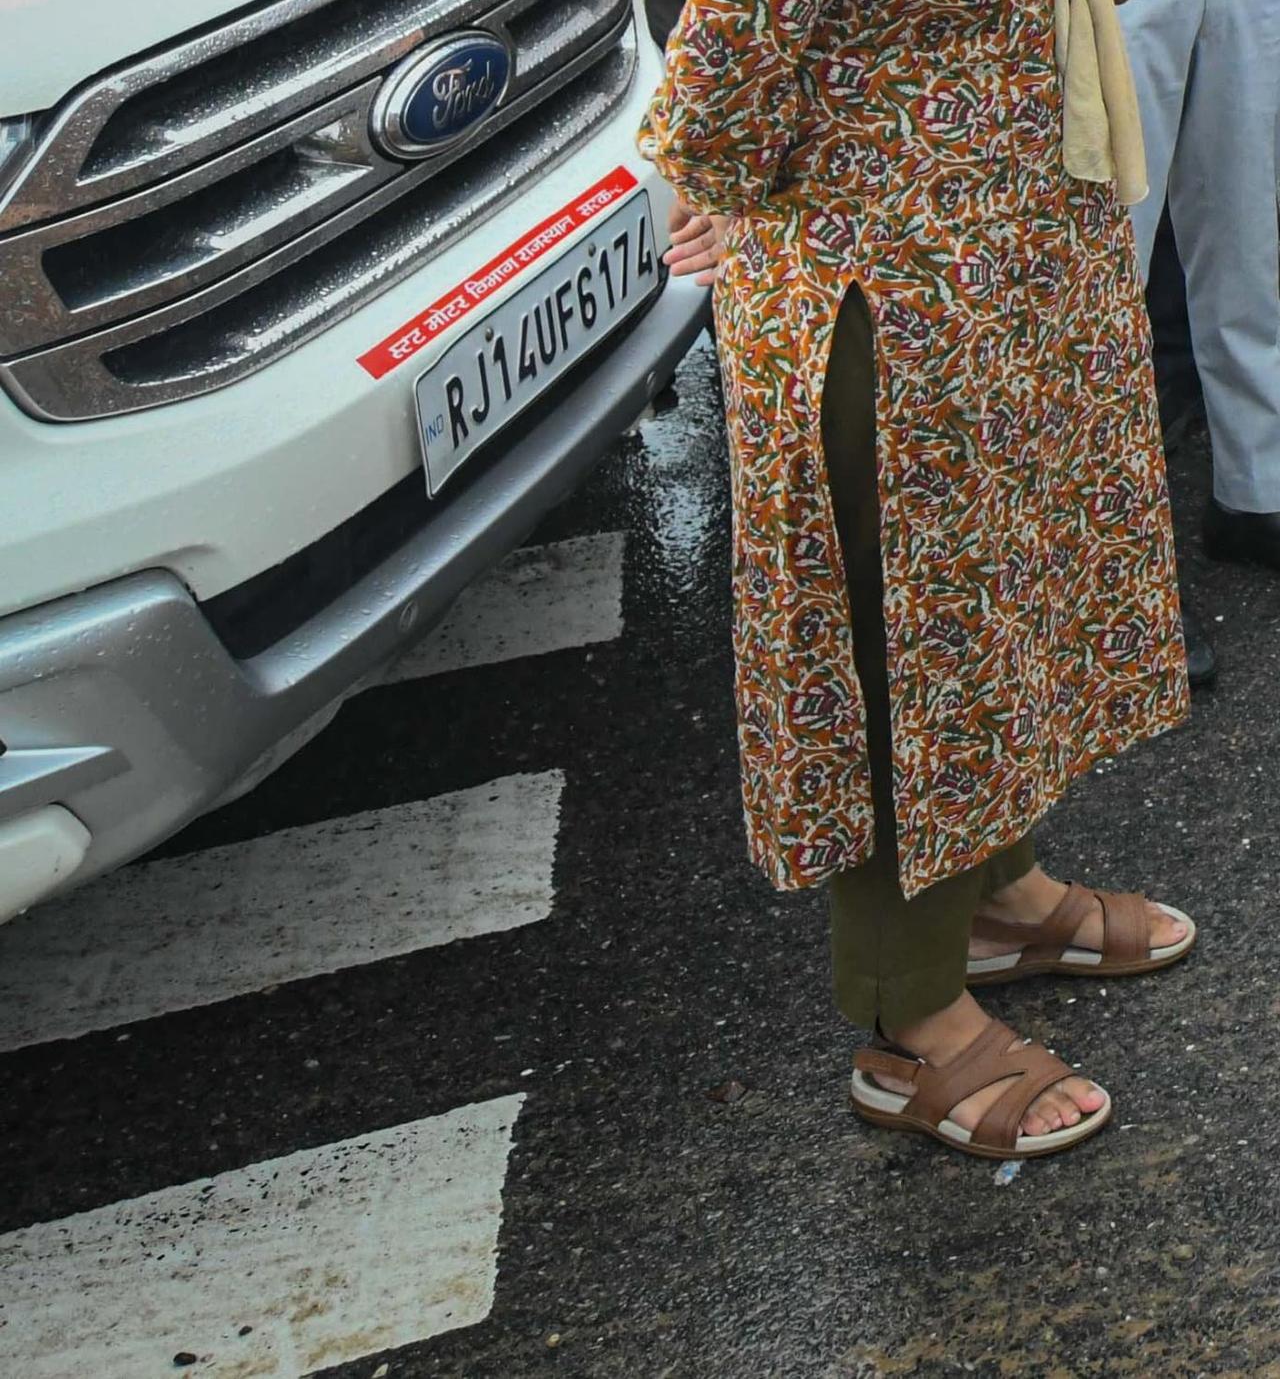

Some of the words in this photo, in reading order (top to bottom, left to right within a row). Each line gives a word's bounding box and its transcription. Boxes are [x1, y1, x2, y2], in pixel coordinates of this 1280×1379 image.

[432, 58, 496, 130] Ford
[422, 294, 470, 332] मोटर
[513, 214, 577, 262] राजस्थान
[444, 215, 654, 450] RJ14UF6174
[423, 413, 445, 447] IND
